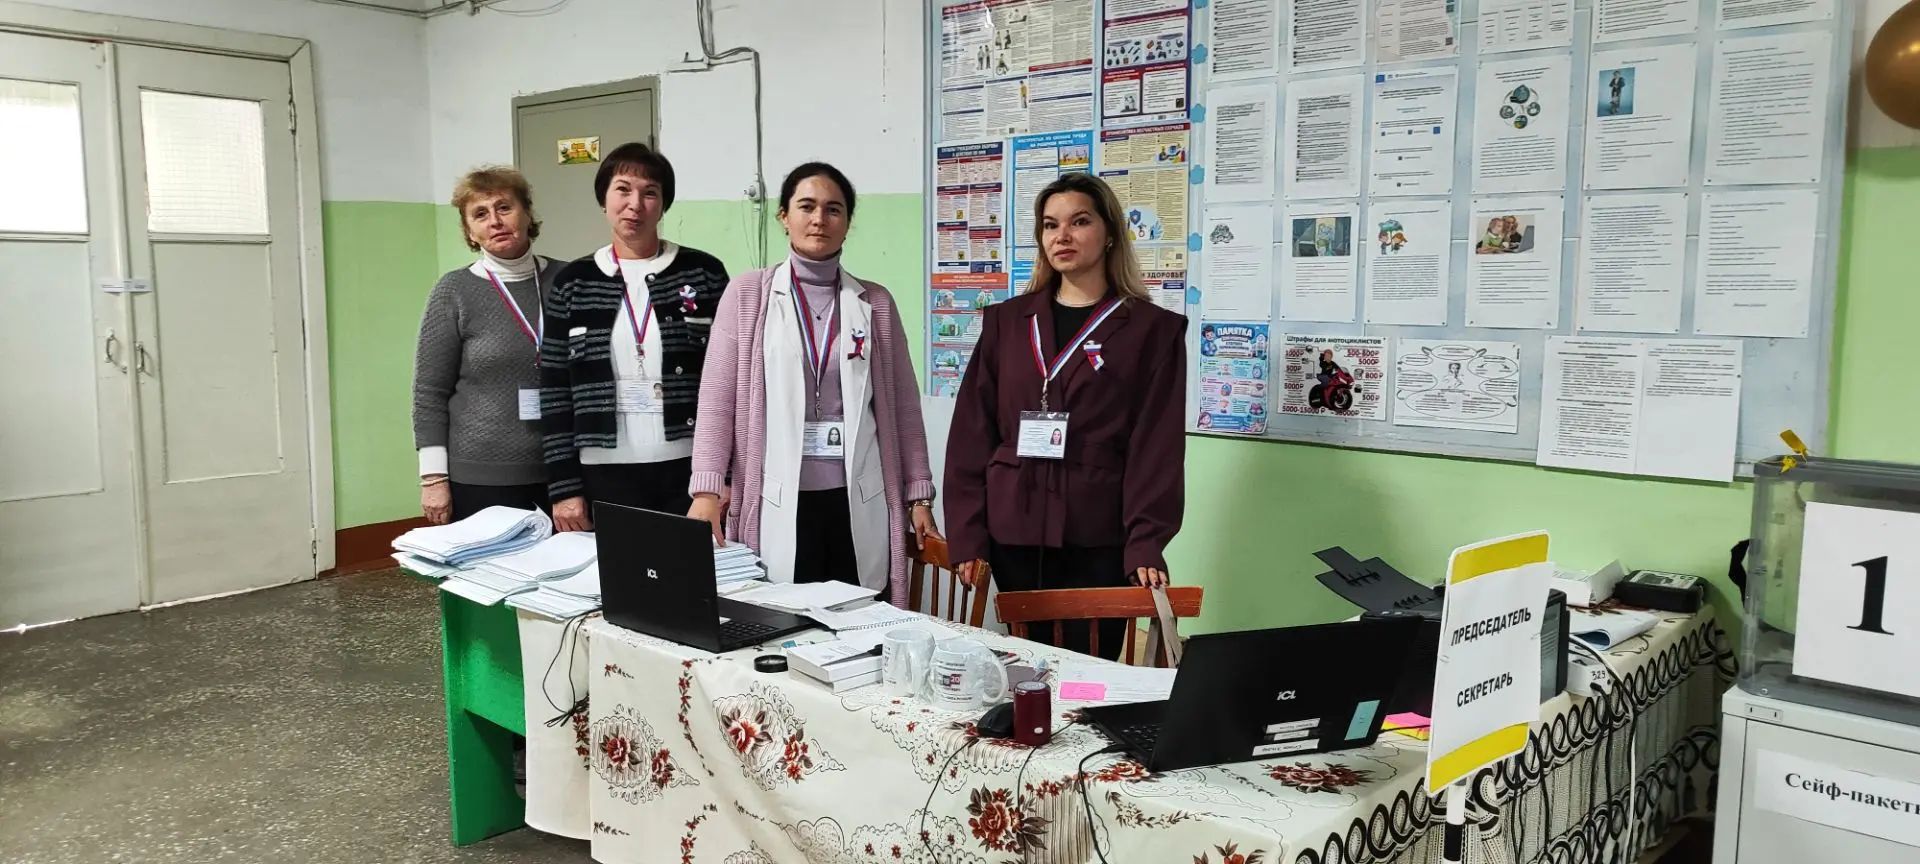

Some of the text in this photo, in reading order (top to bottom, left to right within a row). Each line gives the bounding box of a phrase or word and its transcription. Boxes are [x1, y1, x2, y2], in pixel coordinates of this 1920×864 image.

[1217, 327, 1252, 337] ПАМЯТКА
[1286, 336, 1313, 344] Штрафы
[1846, 555, 1894, 636] 1
[1451, 607, 1531, 646] ПРЕДСЕДАТЕЛЬ
[1457, 672, 1513, 707] СЕКРЕТАРЬ
